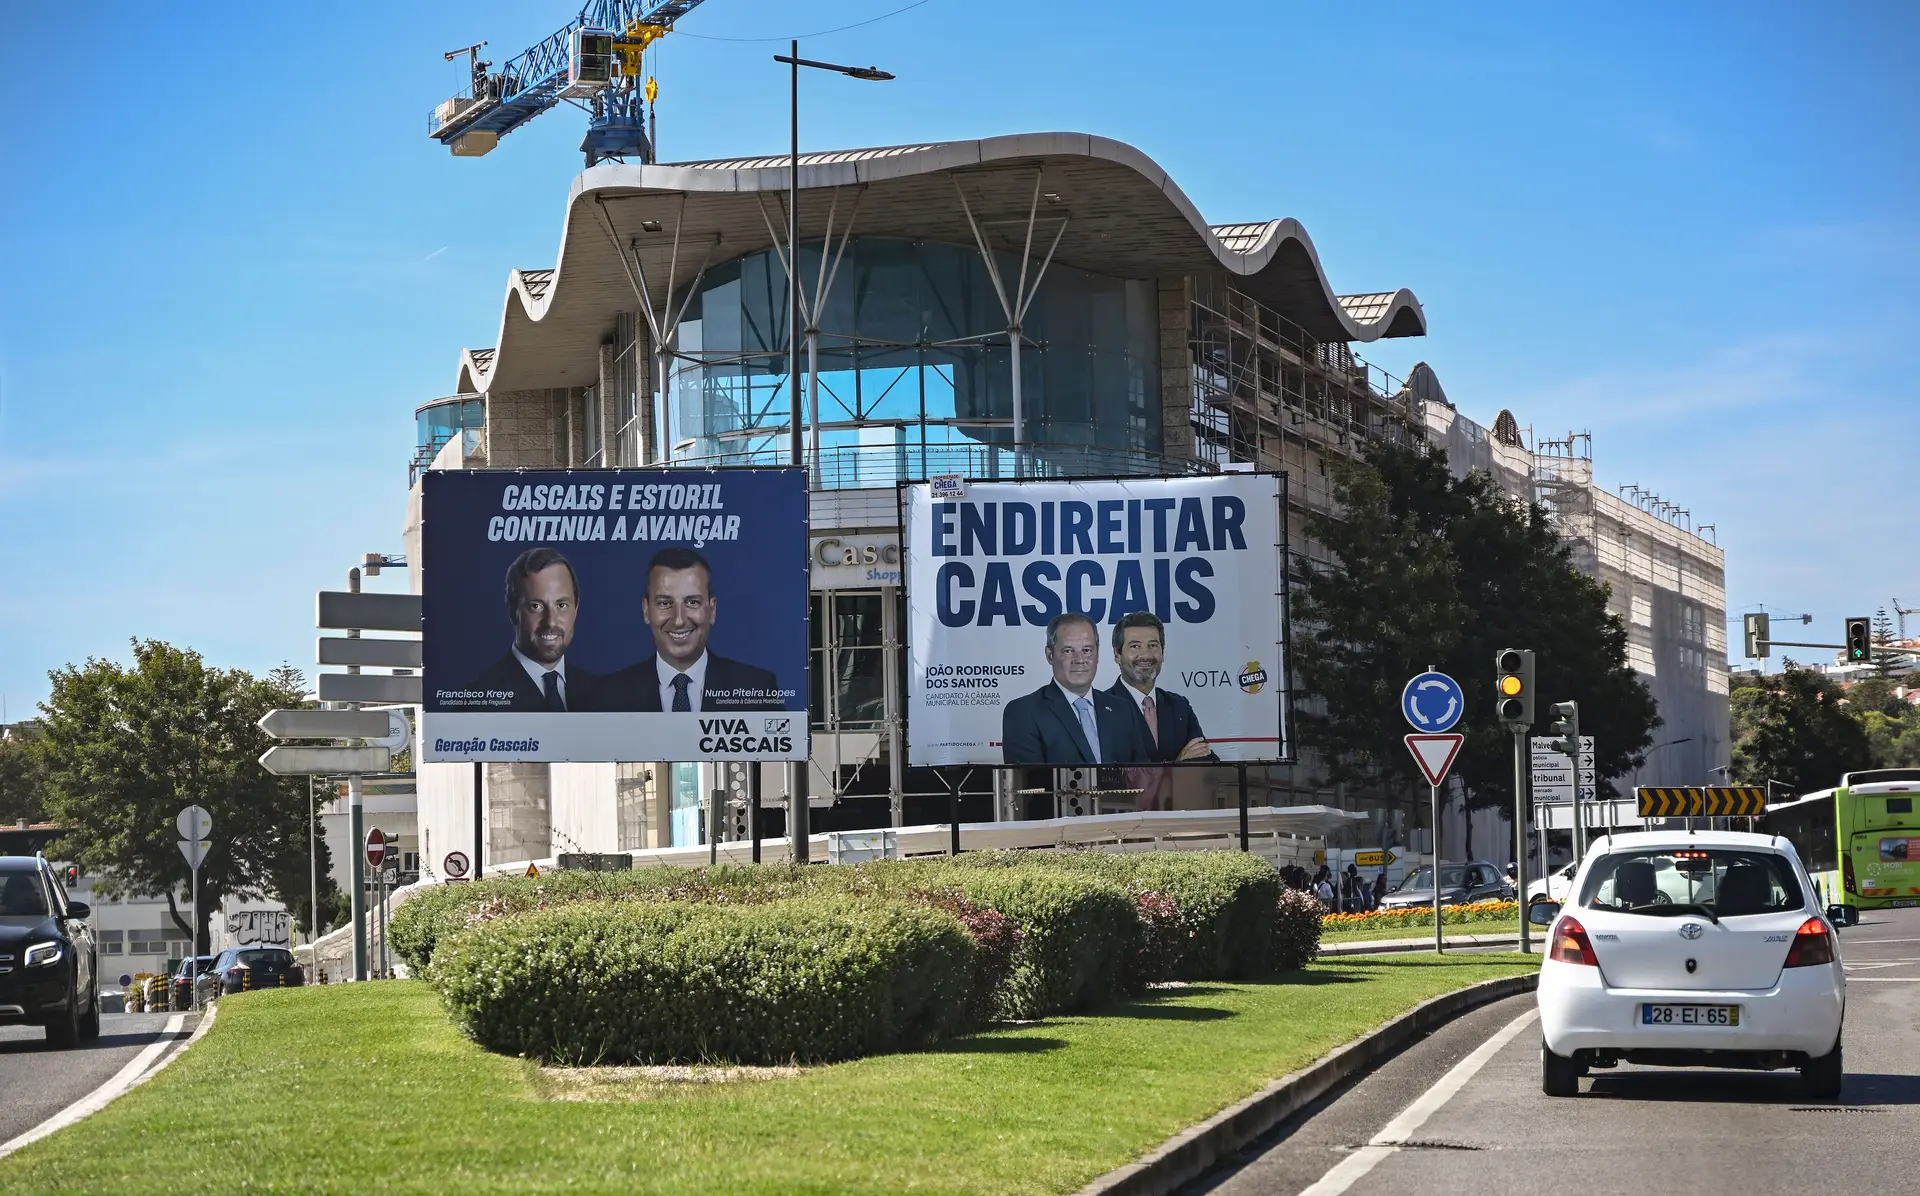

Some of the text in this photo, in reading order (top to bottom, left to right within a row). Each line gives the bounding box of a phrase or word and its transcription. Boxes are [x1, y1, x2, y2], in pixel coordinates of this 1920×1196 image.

[934, 480, 957, 489] CHEGA
[502, 484, 724, 511] CASCAIS E ESTORIL
[487, 515, 741, 549] CONTINUA A AVANÇAR
[931, 496, 1248, 557] ENDIREITAR
[936, 556, 1216, 627] CASCAIS
[925, 664, 1025, 679] JOÃO RODRIGUES
[1181, 670, 1232, 688] VOTA
[1241, 672, 1265, 684] CHEGA
[926, 678, 999, 689] DOS SANTOS
[436, 689, 514, 700] Francisco Kreye
[705, 688, 796, 699] Nuno Piteira Lopes
[925, 691, 1001, 700] CANDIDATO À CÂMARA
[925, 698, 1000, 707] MUNICIPAL DE CASCAIS
[698, 719, 750, 735] VIVA
[434, 737, 540, 755] Geração Cascais
[699, 736, 793, 753] CASCAIS
[1533, 773, 1566, 782] tribunal
